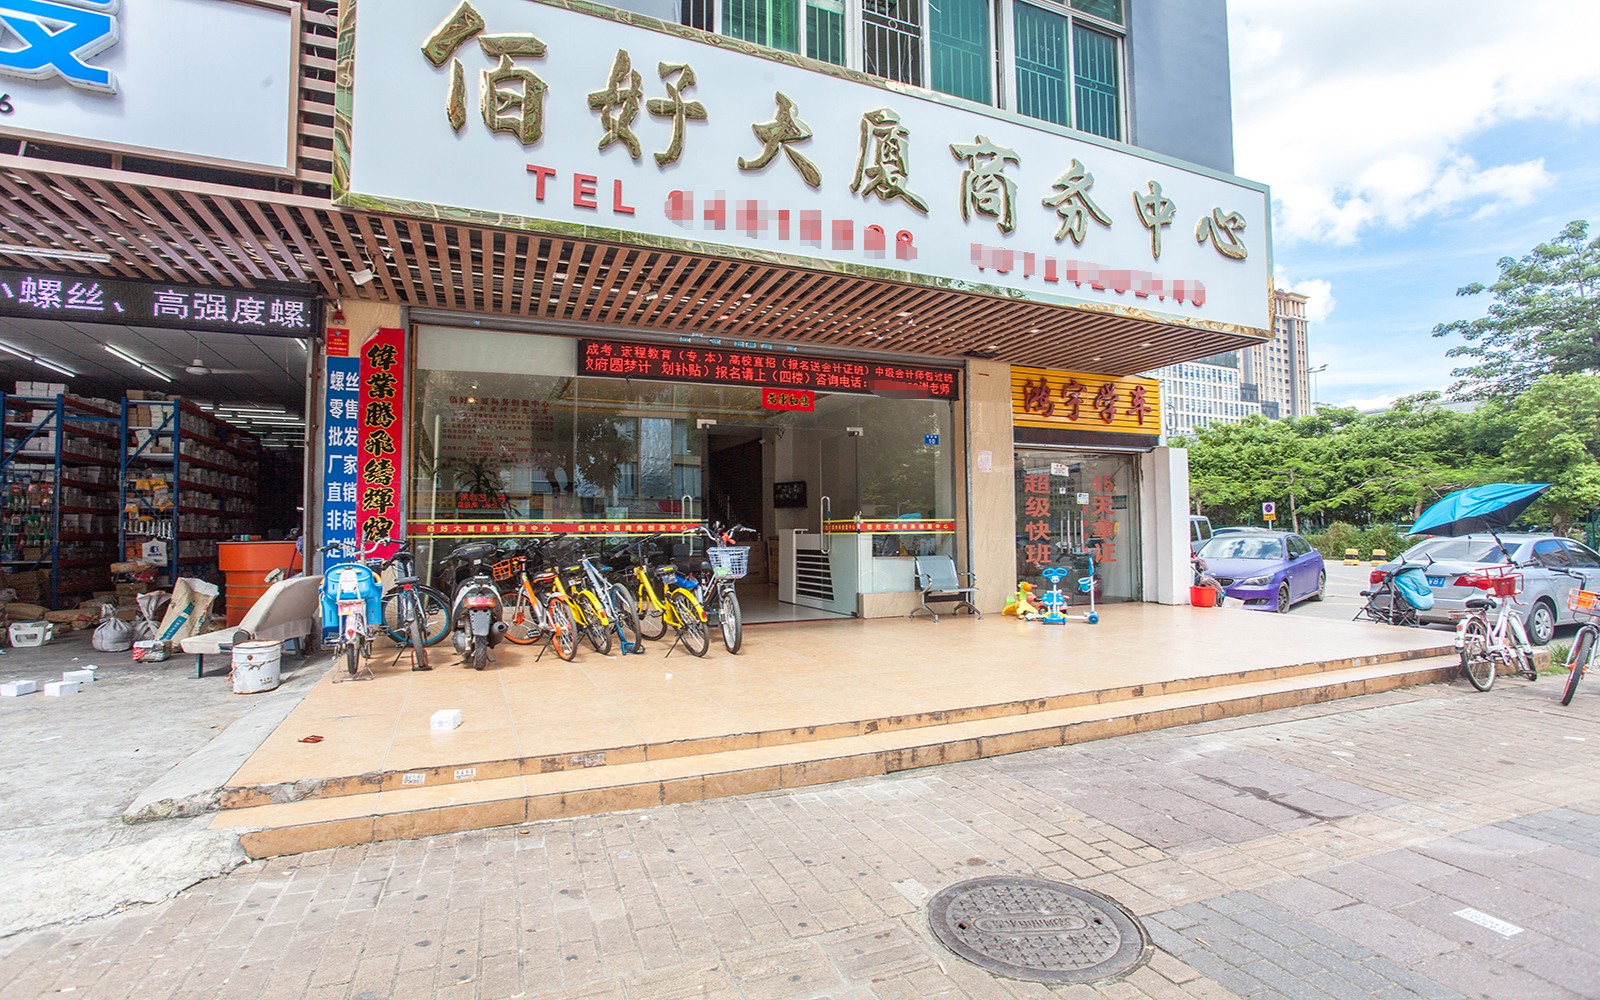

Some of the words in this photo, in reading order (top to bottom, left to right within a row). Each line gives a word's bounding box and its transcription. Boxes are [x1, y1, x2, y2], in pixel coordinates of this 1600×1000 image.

[421, 0, 1249, 262] 佰好大厦商务中心
[526, 164, 635, 214] TEL
[330, 370, 359, 391] 螺丝
[329, 398, 359, 420] 零售
[328, 426, 358, 448] 批发
[327, 454, 358, 475] 厂家
[327, 481, 357, 502] 直销
[327, 509, 357, 531] 非标
[1024, 473, 1052, 564] 超级快班
[1091, 475, 1118, 563] 45天拿证
